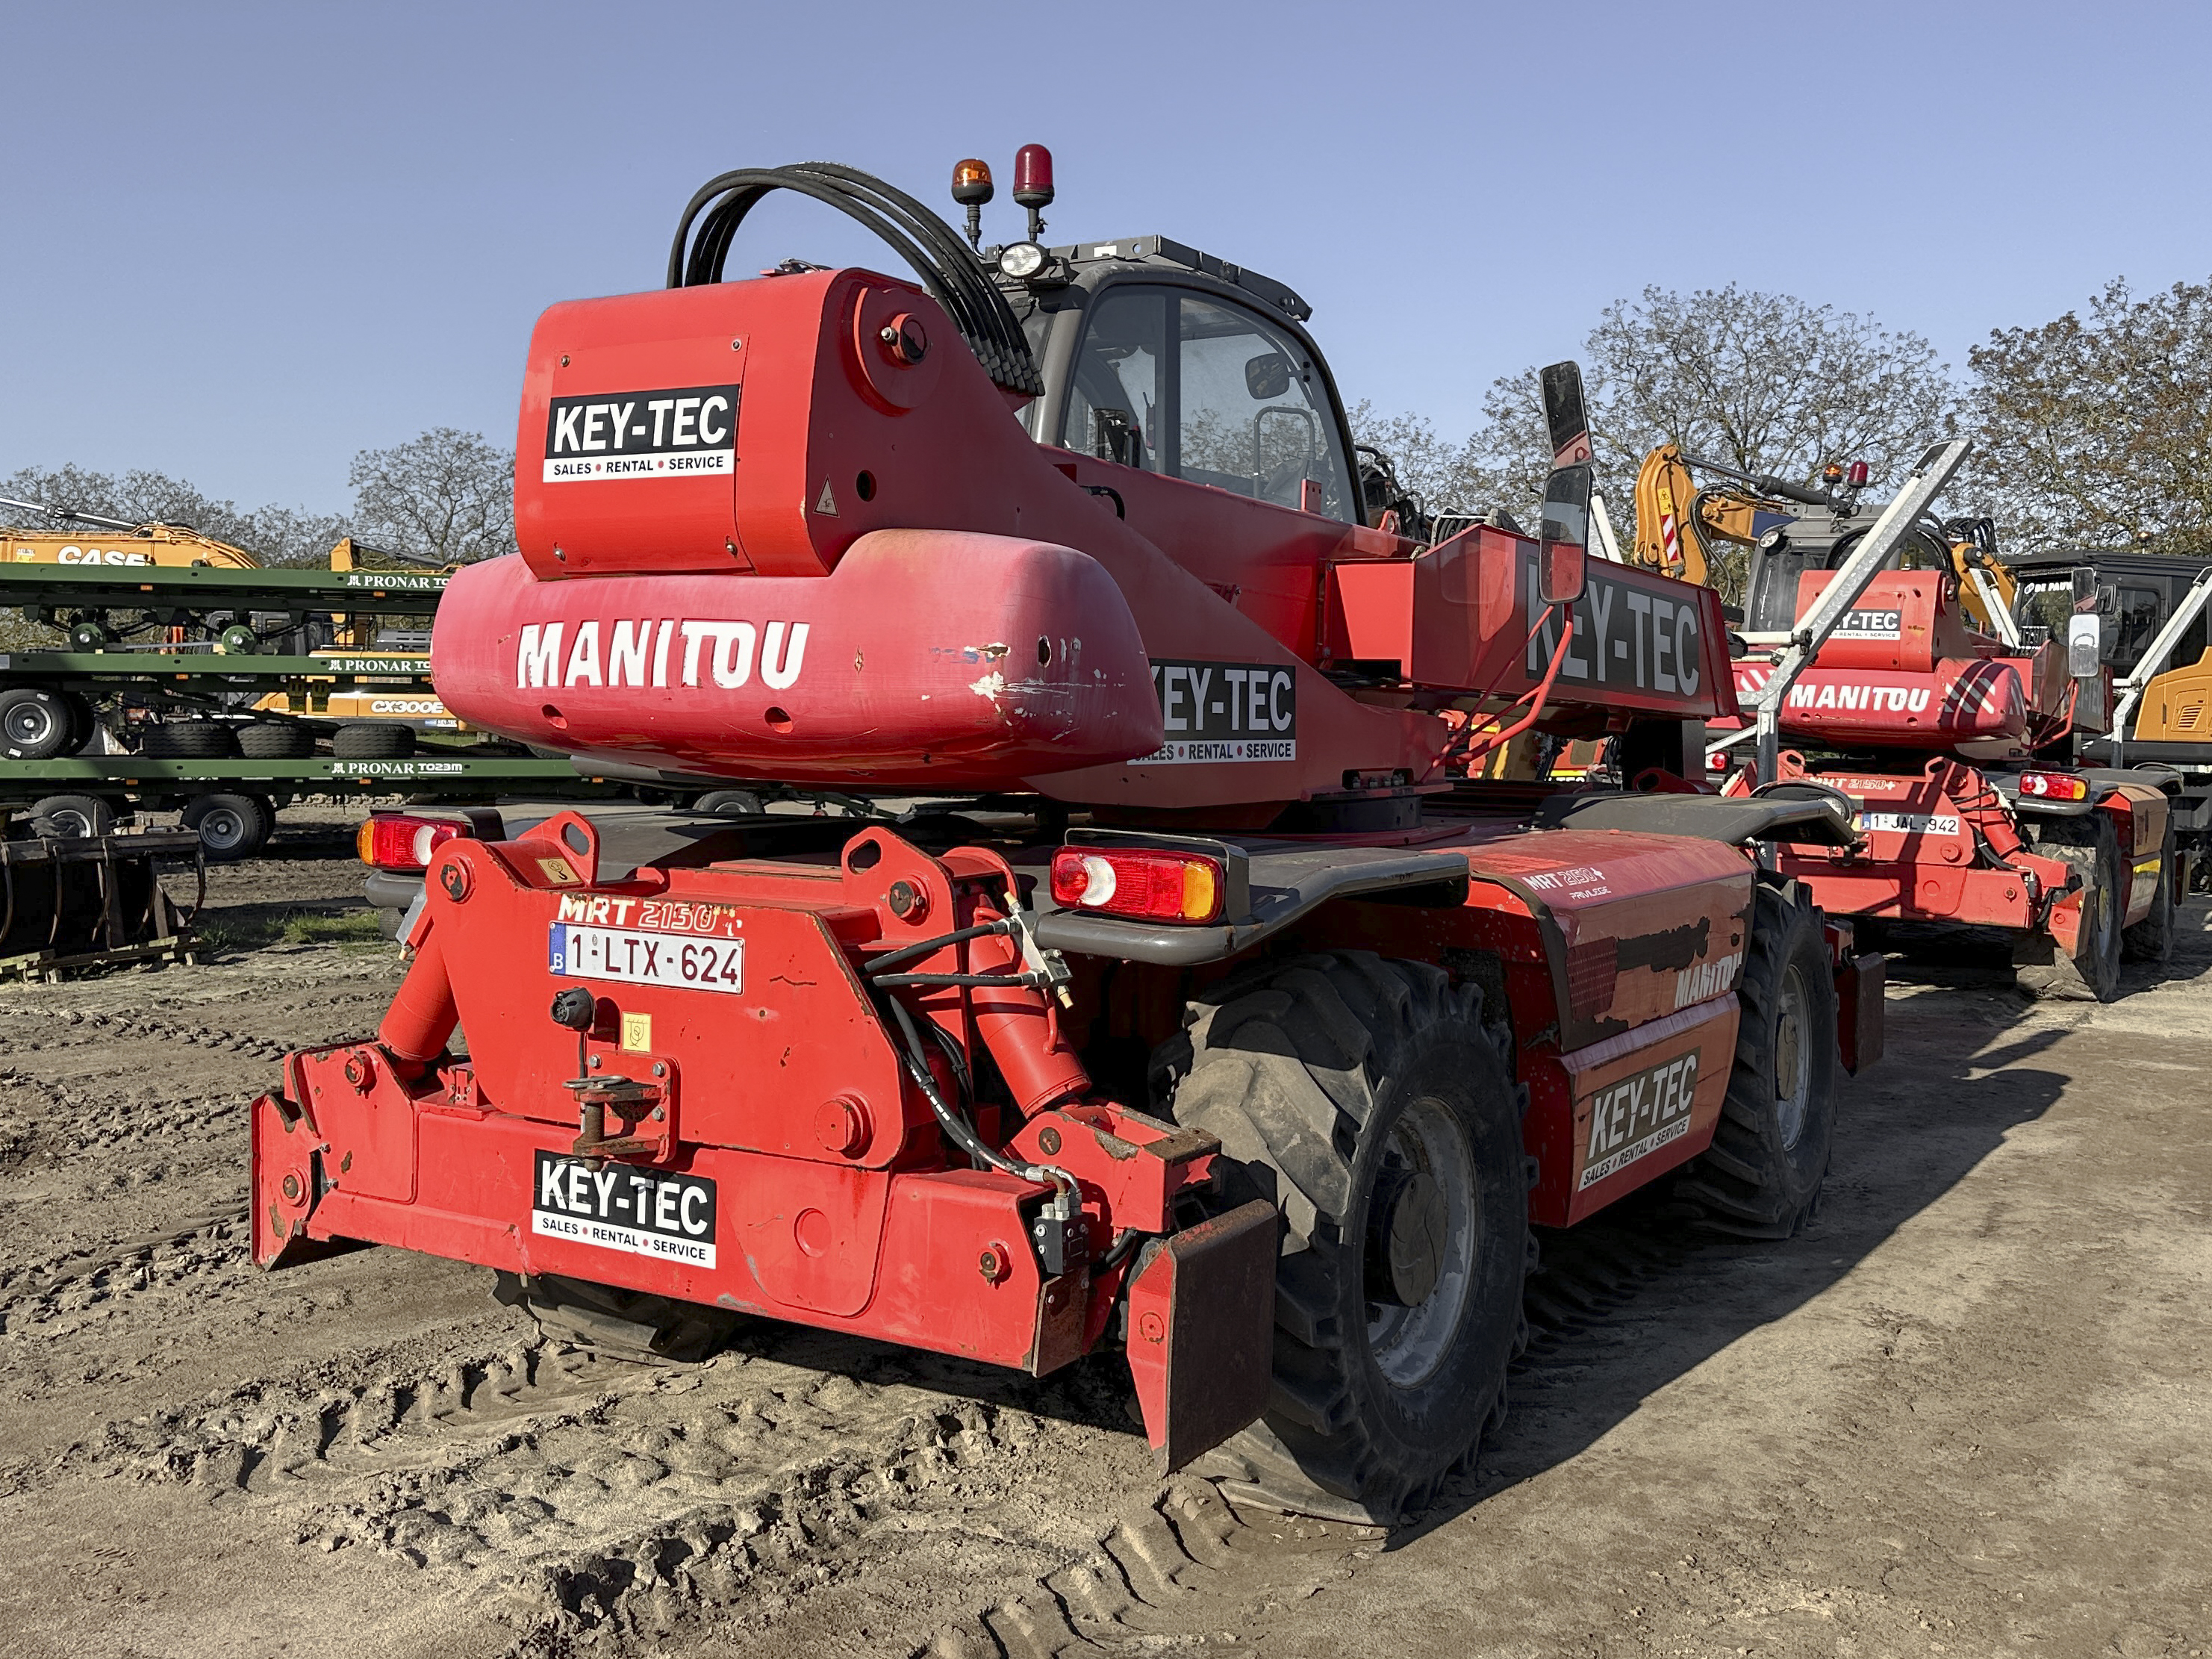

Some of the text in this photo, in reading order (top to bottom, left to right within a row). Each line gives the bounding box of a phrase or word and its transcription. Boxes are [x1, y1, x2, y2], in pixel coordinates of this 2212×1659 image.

[553, 395, 729, 452] KEY-TEC
[553, 456, 724, 476] SALES RENTAL SERVICE
[57, 545, 147, 566] CASE
[364, 575, 431, 588] PRONAR
[2034, 583, 2047, 593] DE
[1836, 611, 1898, 629] Y-TEC
[517, 618, 811, 690] MANITOU
[345, 660, 411, 672] PRONAR
[371, 700, 444, 714] CX300E
[1150, 665, 1292, 732] EY-TEC
[1789, 683, 1931, 713] MANITOU
[1188, 743, 1234, 760] RENTAL
[1246, 742, 1292, 759] SERVICE
[348, 762, 414, 774] PRONAR
[1521, 873, 1564, 891] MRT
[557, 894, 635, 925] MRT
[553, 952, 564, 970] B
[572, 933, 738, 985] 1-LTX-624
[1588, 1053, 1697, 1160] KEY-TEC
[1583, 1118, 1687, 1186] SALES RENTAL SERVICE
[540, 1160, 708, 1236] KEY-TEC
[542, 1216, 706, 1260] SALES RENTAL SERVICE
